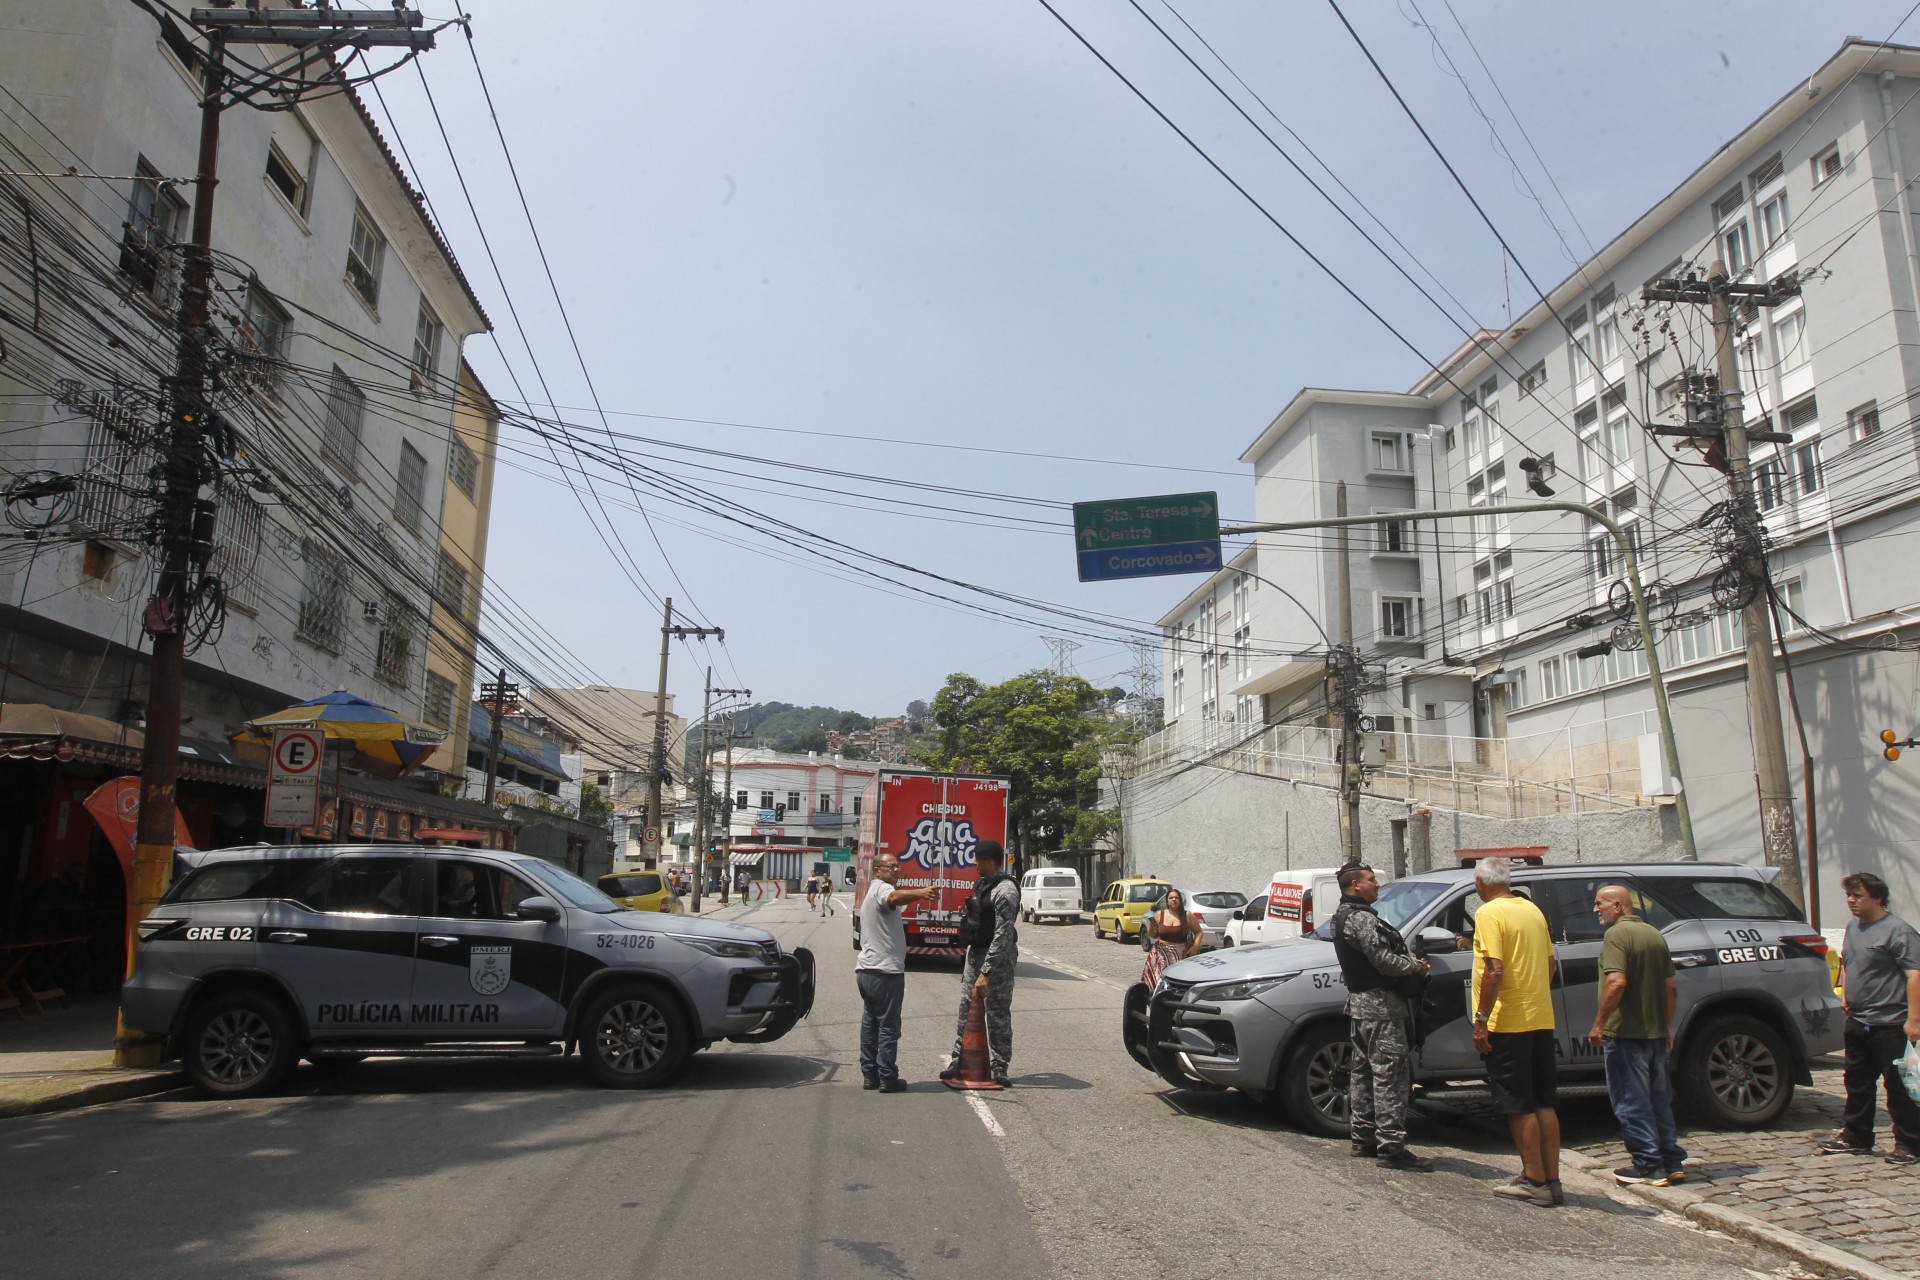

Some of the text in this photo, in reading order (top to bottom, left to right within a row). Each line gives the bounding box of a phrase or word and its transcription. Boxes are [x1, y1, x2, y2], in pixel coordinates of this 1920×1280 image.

[1103, 505, 1189, 522] Sta. Teresa
[1100, 527, 1152, 542] Centro
[1109, 551, 1194, 570] Corcovado
[288, 742, 306, 765] E
[892, 778, 998, 791] IN J4198
[922, 803, 966, 815] CHEGOU
[648, 830, 654, 839] E
[1273, 886, 1303, 899] LALAMOVE
[186, 927, 253, 941] GRE 02
[919, 926, 958, 934] FACCHINI
[1724, 928, 1763, 943] 190
[596, 933, 655, 949] 52-4026
[1718, 946, 1779, 964] GRE 07
[317, 1000, 500, 1024] POLÍCIA MILITAR
